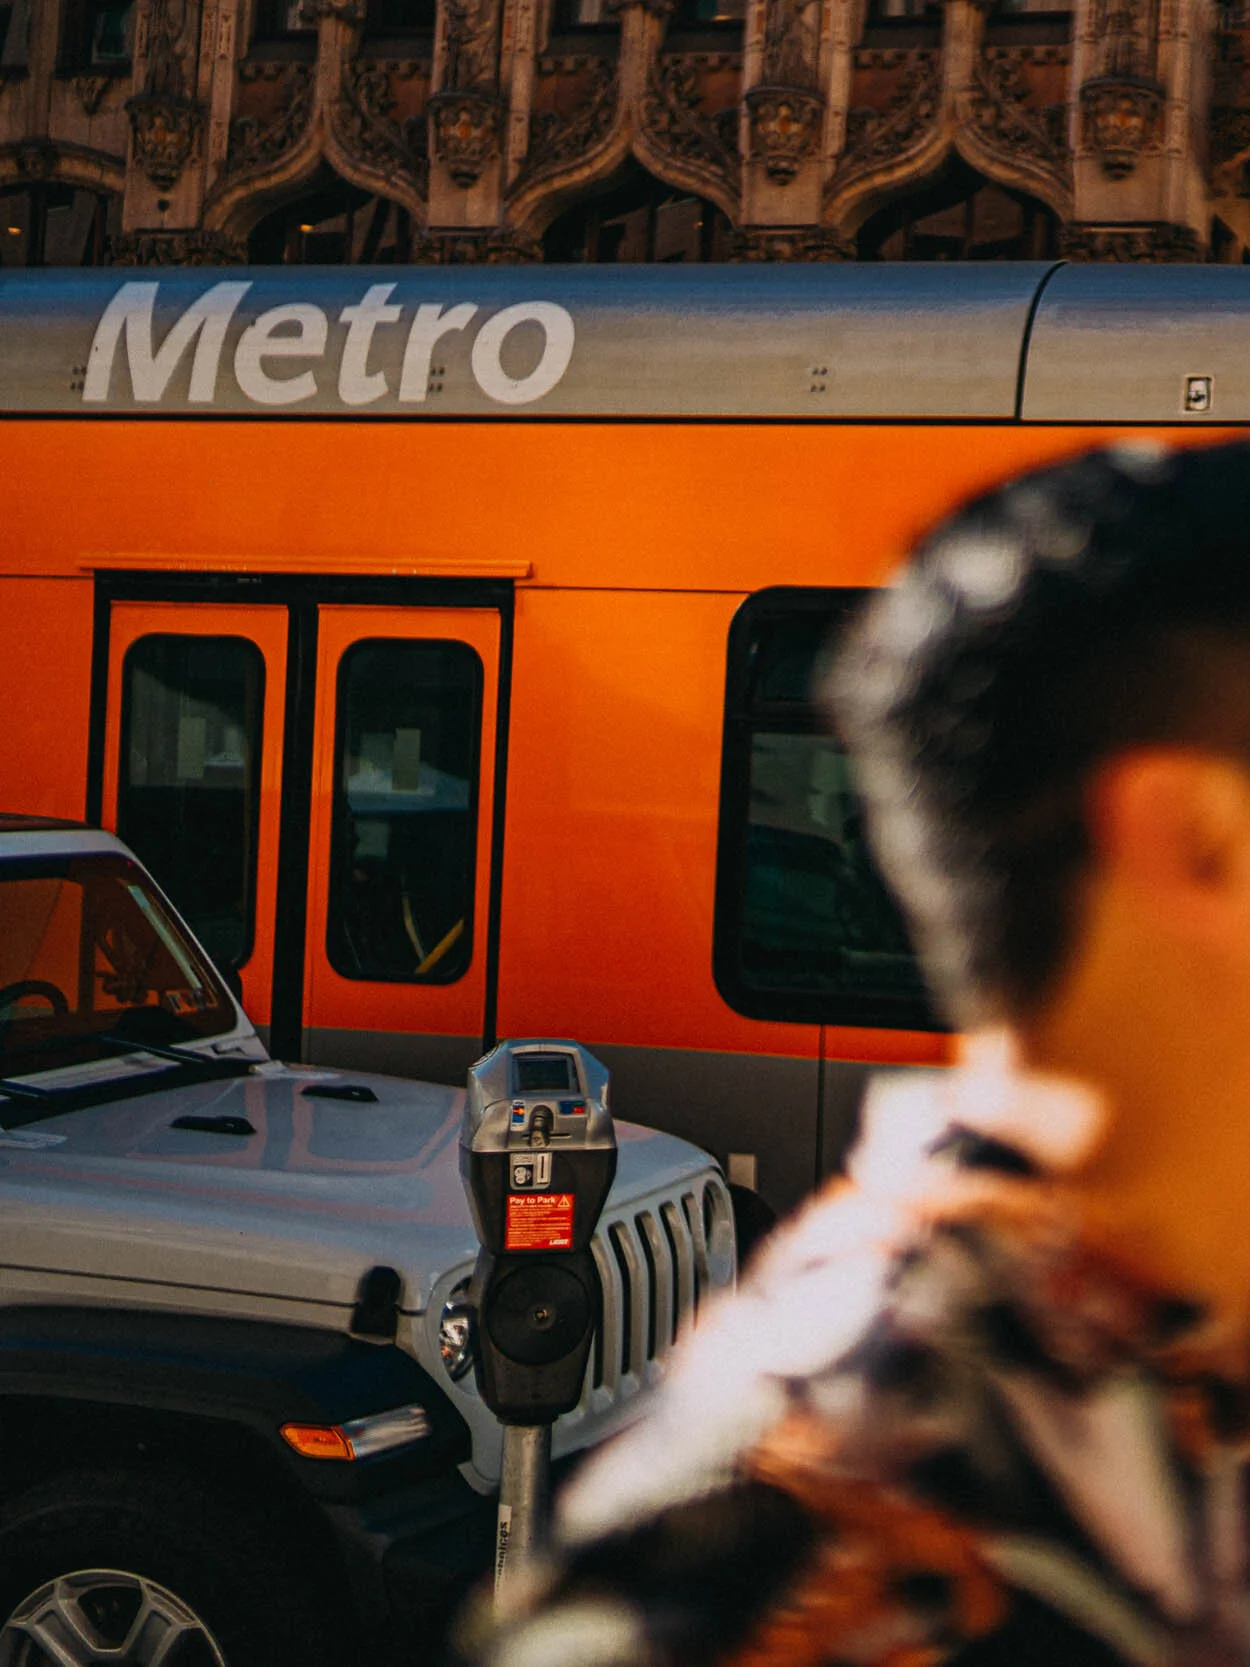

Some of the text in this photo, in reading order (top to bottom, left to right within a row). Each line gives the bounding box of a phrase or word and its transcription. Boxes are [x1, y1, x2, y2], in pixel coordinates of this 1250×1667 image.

[82, 281, 576, 406] Metro
[509, 1197, 525, 1206] Pay
[537, 1196, 556, 1204] Park
